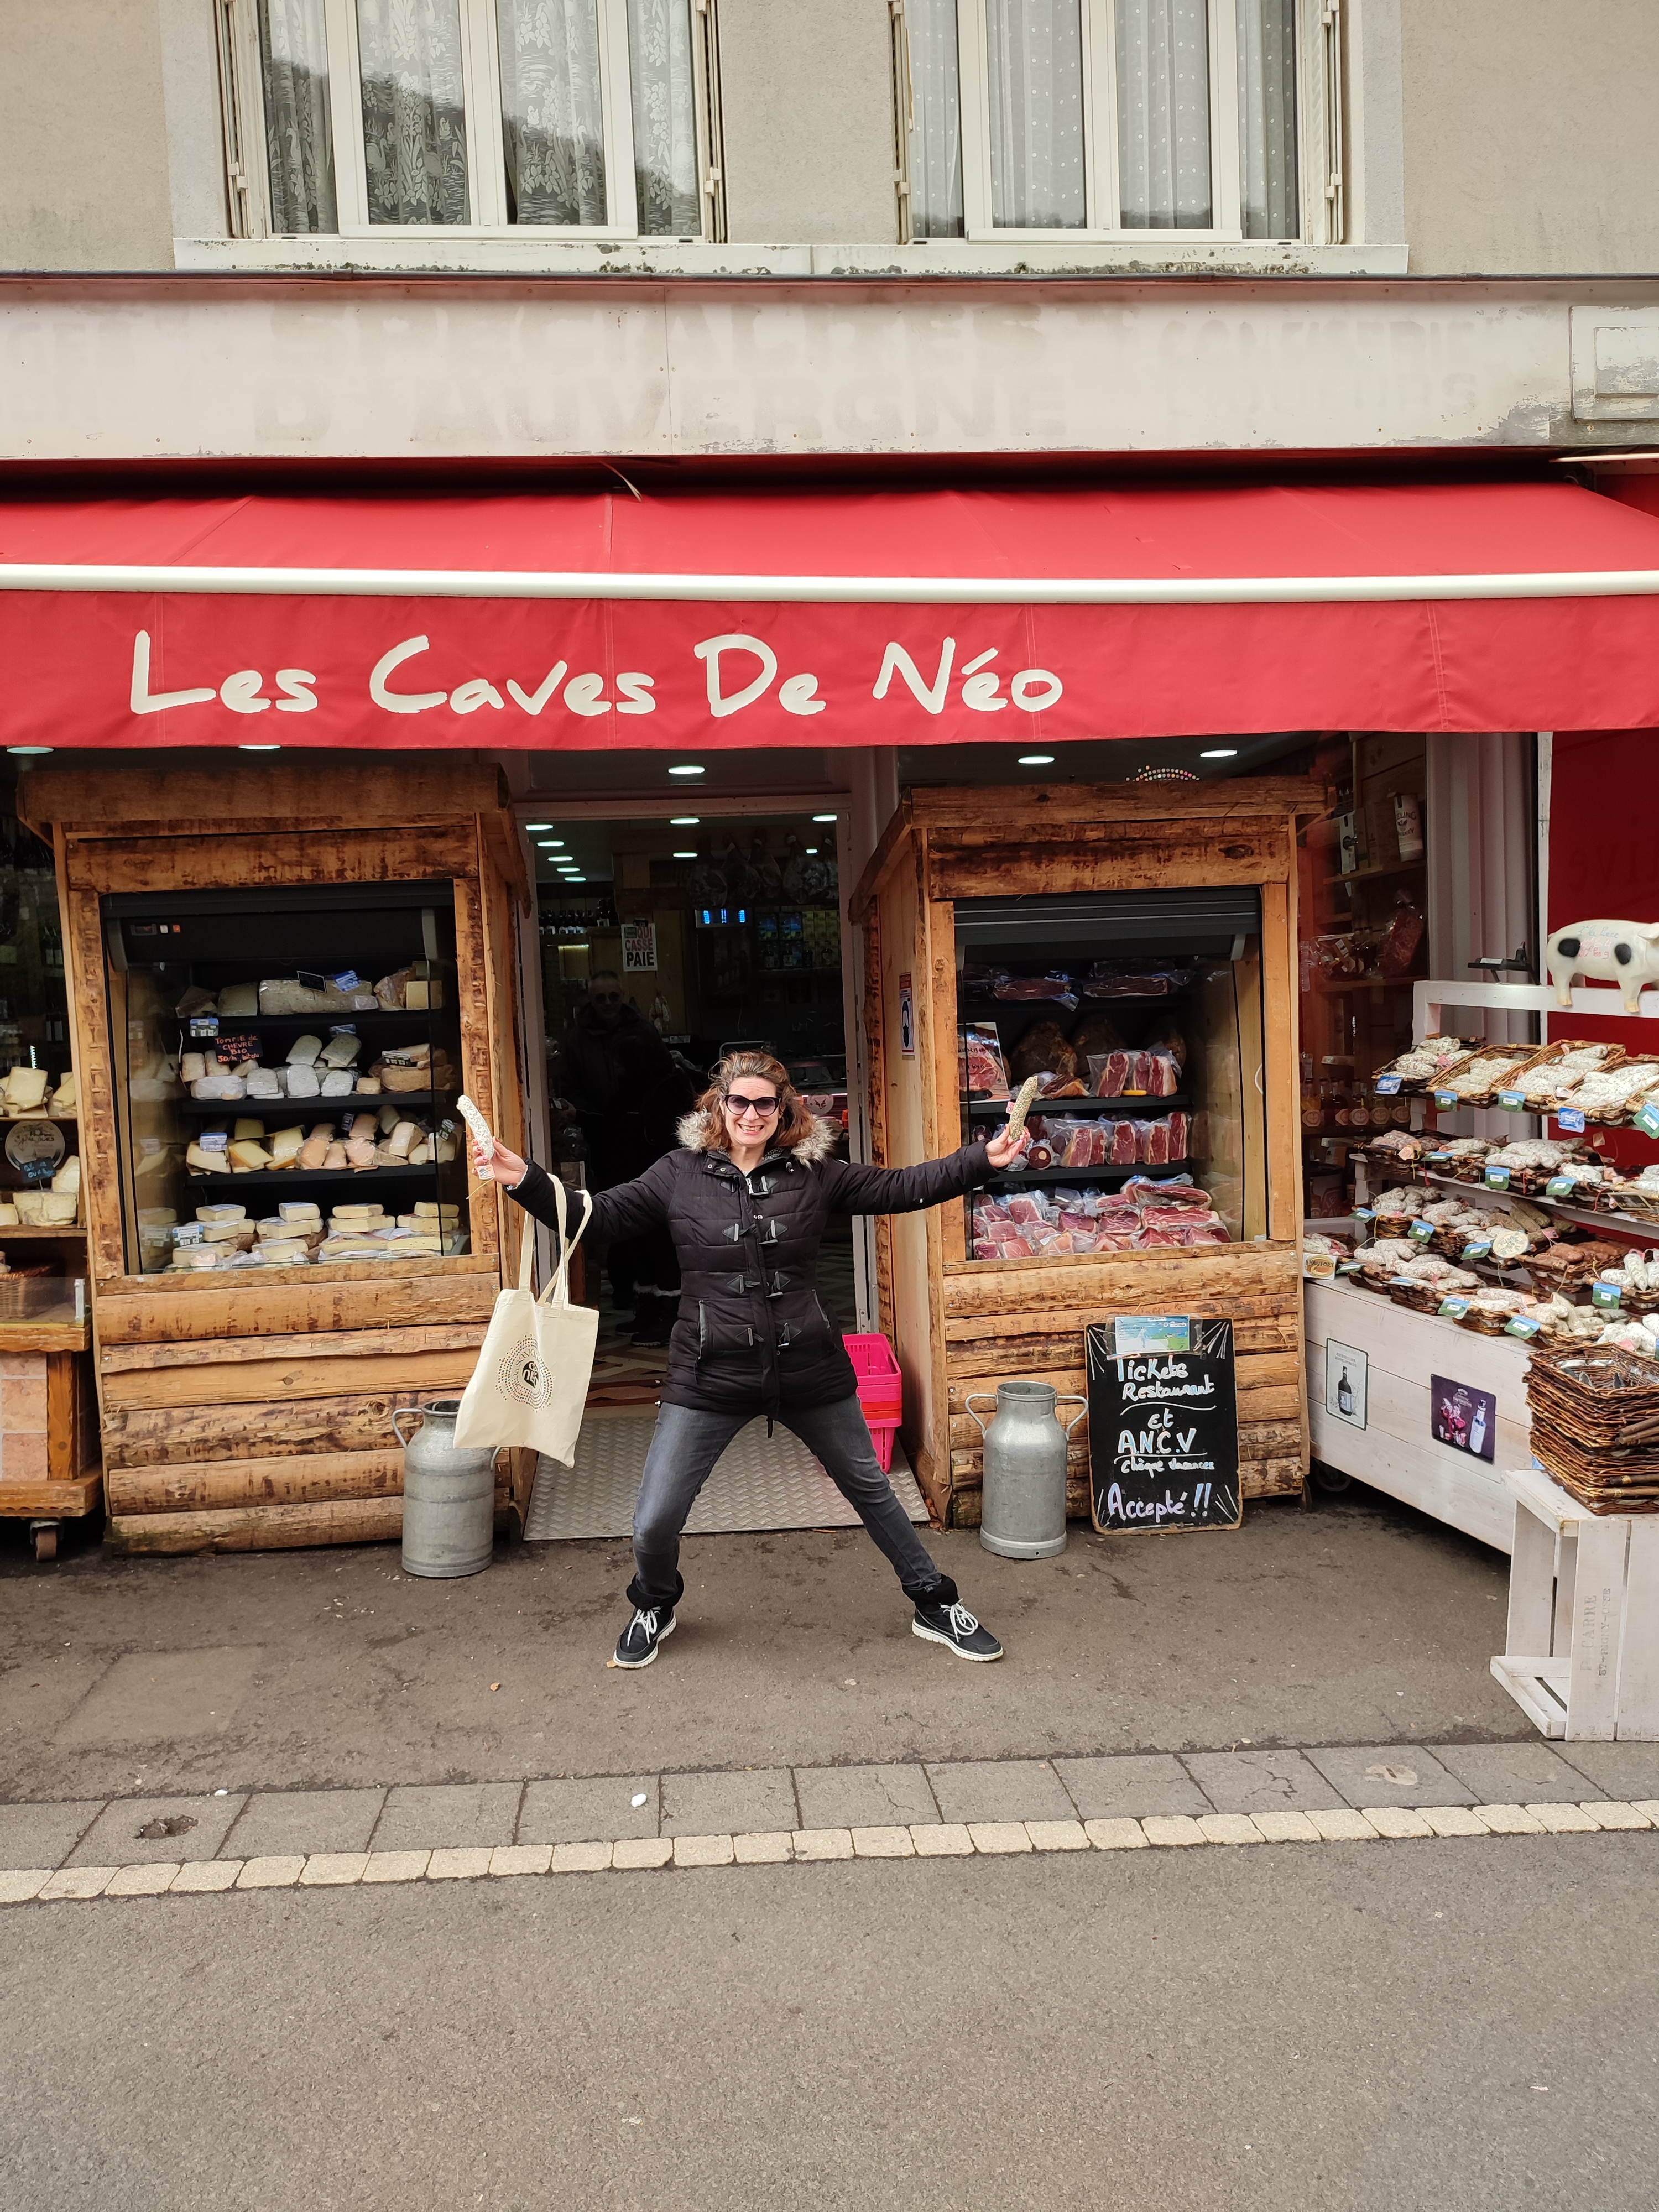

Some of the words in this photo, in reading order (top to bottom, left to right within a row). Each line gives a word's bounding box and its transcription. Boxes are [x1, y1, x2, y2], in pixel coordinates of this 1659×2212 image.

[130, 630, 318, 714] Les
[369, 634, 656, 715] Caves
[694, 633, 826, 717] De
[872, 635, 1063, 714] Néo
[637, 927, 652, 938] QUI
[625, 939, 653, 951] CASSE
[627, 951, 654, 967] PAIE
[1306, 1259, 1334, 1268] BEAUFORT
[1122, 1374, 1215, 1401] Restaurant
[1582, 1595, 1597, 1648] CARRE
